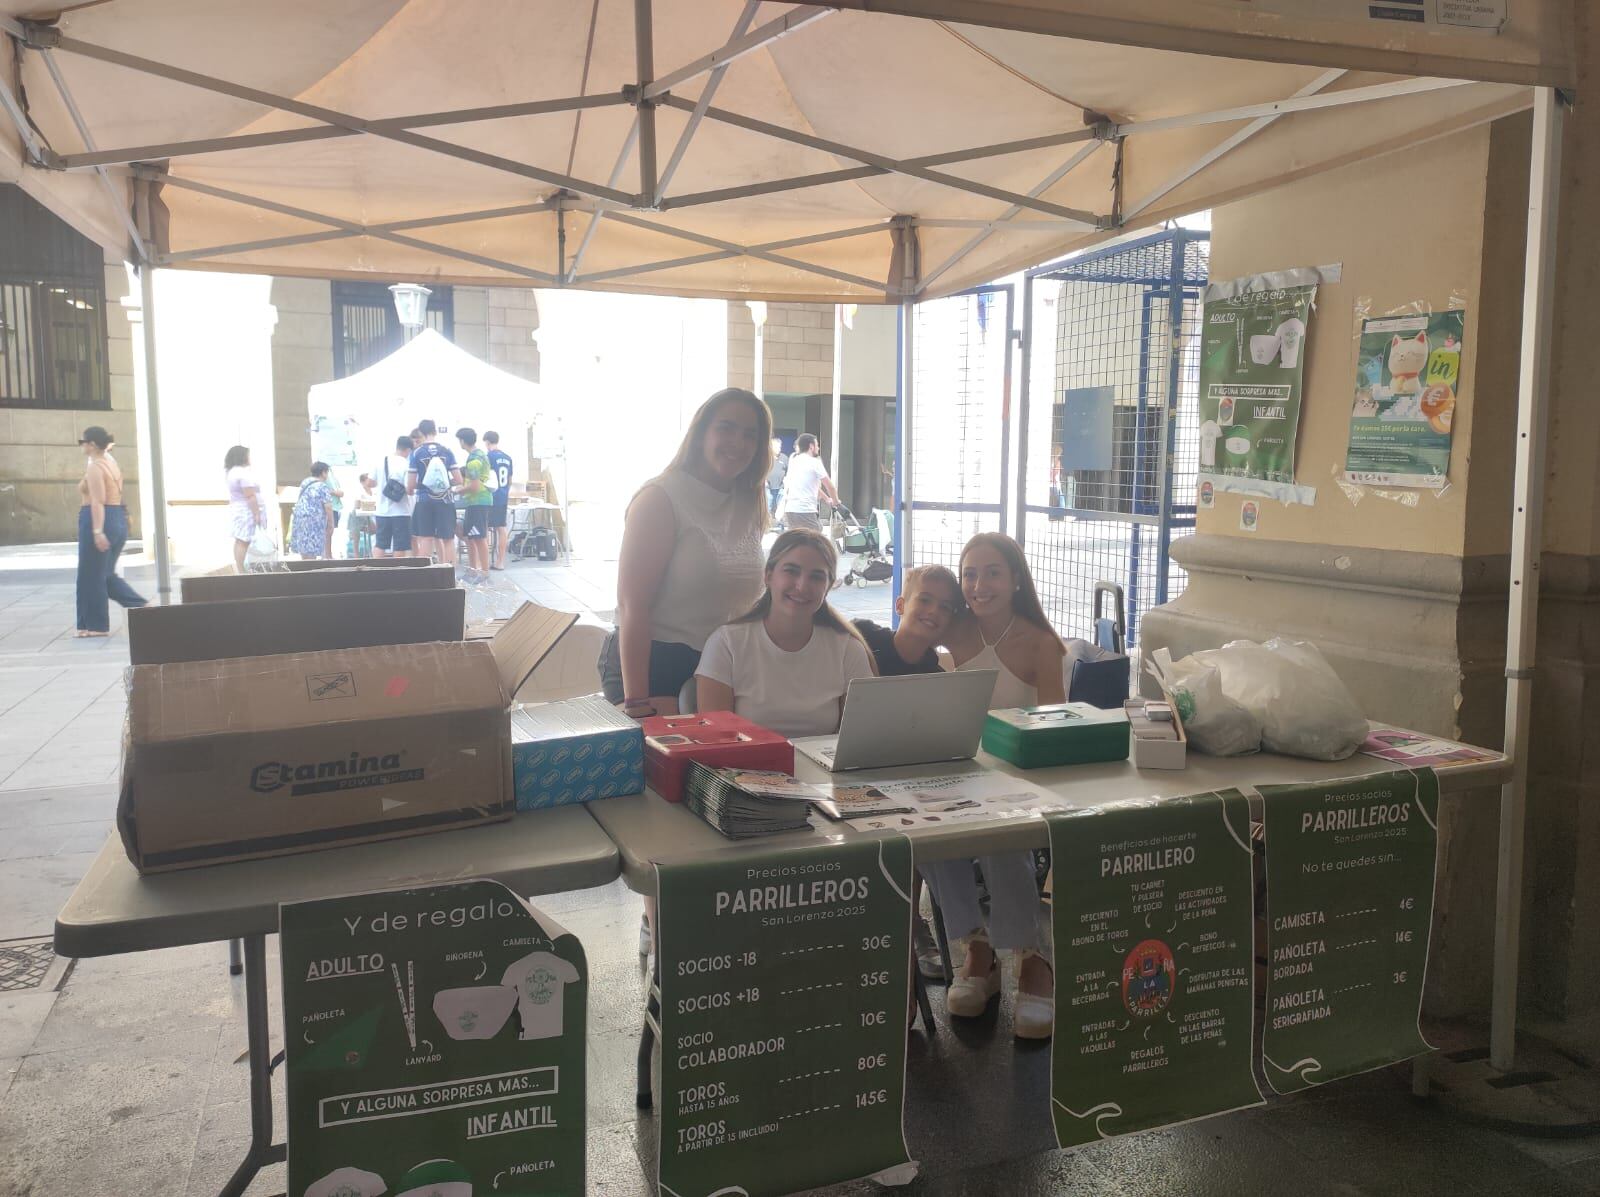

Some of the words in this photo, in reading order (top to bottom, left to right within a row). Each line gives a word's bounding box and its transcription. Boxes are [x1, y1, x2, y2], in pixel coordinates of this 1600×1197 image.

[1211, 313, 1236, 322] ADULTO
[1431, 354, 1455, 380] in
[1254, 406, 1286, 418] INFANTIL
[499, 466, 508, 488] 8
[251, 752, 400, 793] Stamina
[1325, 793, 1361, 803] Precios
[1362, 790, 1392, 800] socios
[1301, 802, 1411, 833] PARRILLEROS
[1100, 839, 1149, 853] Beneficios
[1150, 835, 1161, 846] de
[1162, 831, 1198, 844] hacerte
[1334, 835, 1350, 844] San
[1351, 830, 1384, 843] Lorenzo
[1385, 827, 1407, 837] 2025
[1101, 846, 1195, 877] PARRILLERO
[1302, 862, 1319, 874] No
[1321, 860, 1334, 872] te
[1336, 855, 1376, 871] quedes
[747, 867, 797, 880] Precios
[799, 862, 841, 875] socios
[715, 876, 870, 916] PARRILLEROS
[1178, 887, 1214, 900] DESCUENTO
[1133, 905, 1141, 914] DE
[1143, 901, 1163, 912] SOCIO
[1174, 902, 1186, 912] LAS
[1187, 895, 1227, 909] ACTIVIDADES
[1400, 898, 1414, 911] 4€
[761, 916, 785, 927] San
[786, 909, 835, 925] Lorenzo
[836, 905, 866, 917] 2025
[1080, 909, 1119, 923] DESCUENTO
[1192, 910, 1200, 919] LA
[1274, 911, 1326, 932] CAMISETA
[343, 916, 362, 937] Y
[371, 911, 409, 933] de
[1090, 923, 1100, 932] EN
[1100, 922, 1109, 930] EL
[503, 937, 541, 947] CAMISETA
[861, 934, 891, 951] 30€
[1072, 935, 1095, 946] ABONO
[1096, 933, 1105, 942] DE
[1107, 929, 1129, 940] TOROS
[1200, 931, 1218, 942] BONO
[1273, 940, 1326, 963] PAÑOLETA
[307, 953, 384, 979] ADULTO
[678, 954, 732, 976] SOCIOS
[736, 951, 757, 967] -18
[1273, 961, 1313, 981] BORDADA
[860, 971, 889, 987] 35€
[1076, 970, 1106, 984] ENTRADA
[1221, 969, 1230, 977] DE
[1231, 968, 1245, 976] LAS
[1393, 971, 1408, 984] 3€
[1083, 984, 1089, 993] A
[1090, 982, 1099, 992] LA
[1144, 980, 1156, 989] LA
[678, 991, 731, 1015] SOCIOS
[736, 988, 760, 1003] +18
[1273, 988, 1324, 1012] PAÑOLETA
[302, 1008, 346, 1024] PAÑOLETA
[860, 1011, 887, 1028] 10€
[1184, 1008, 1220, 1023] DESCUENTO
[1272, 1005, 1332, 1030] SERIGRAFIADA
[1081, 1020, 1116, 1034] ENTRADAS
[1189, 1022, 1201, 1032] LAS
[678, 1031, 714, 1049] SOCIO
[1088, 1034, 1094, 1042] A
[1095, 1031, 1108, 1041] LAS
[1190, 1033, 1202, 1043] LAS
[678, 1036, 786, 1070] COLABORADOR
[1080, 1040, 1116, 1055] VAQUILLAS
[1130, 1045, 1165, 1061] REGALOS
[405, 1053, 442, 1066] LANYARD
[857, 1053, 888, 1071] 80€
[1122, 1057, 1169, 1074] PARRILLEROS
[340, 1102, 350, 1116] Y
[356, 1095, 417, 1113] ALGUNA
[423, 1086, 493, 1105] SORPRESA
[498, 1076, 540, 1094] MAS...
[678, 1081, 726, 1105] TOROS
[855, 1089, 888, 1109] 145€
[678, 1101, 705, 1117] HASTA
[707, 1099, 716, 1110] 15
[718, 1094, 741, 1107] AÑOS
[467, 1105, 557, 1137] INFANTIL
[678, 1119, 726, 1144] TOROS
[676, 1145, 684, 1155] A
[685, 1138, 713, 1153] PARTIR
[715, 1134, 726, 1145] DE
[727, 1132, 737, 1142] 15
[509, 1159, 556, 1176] PAÑOLETA
